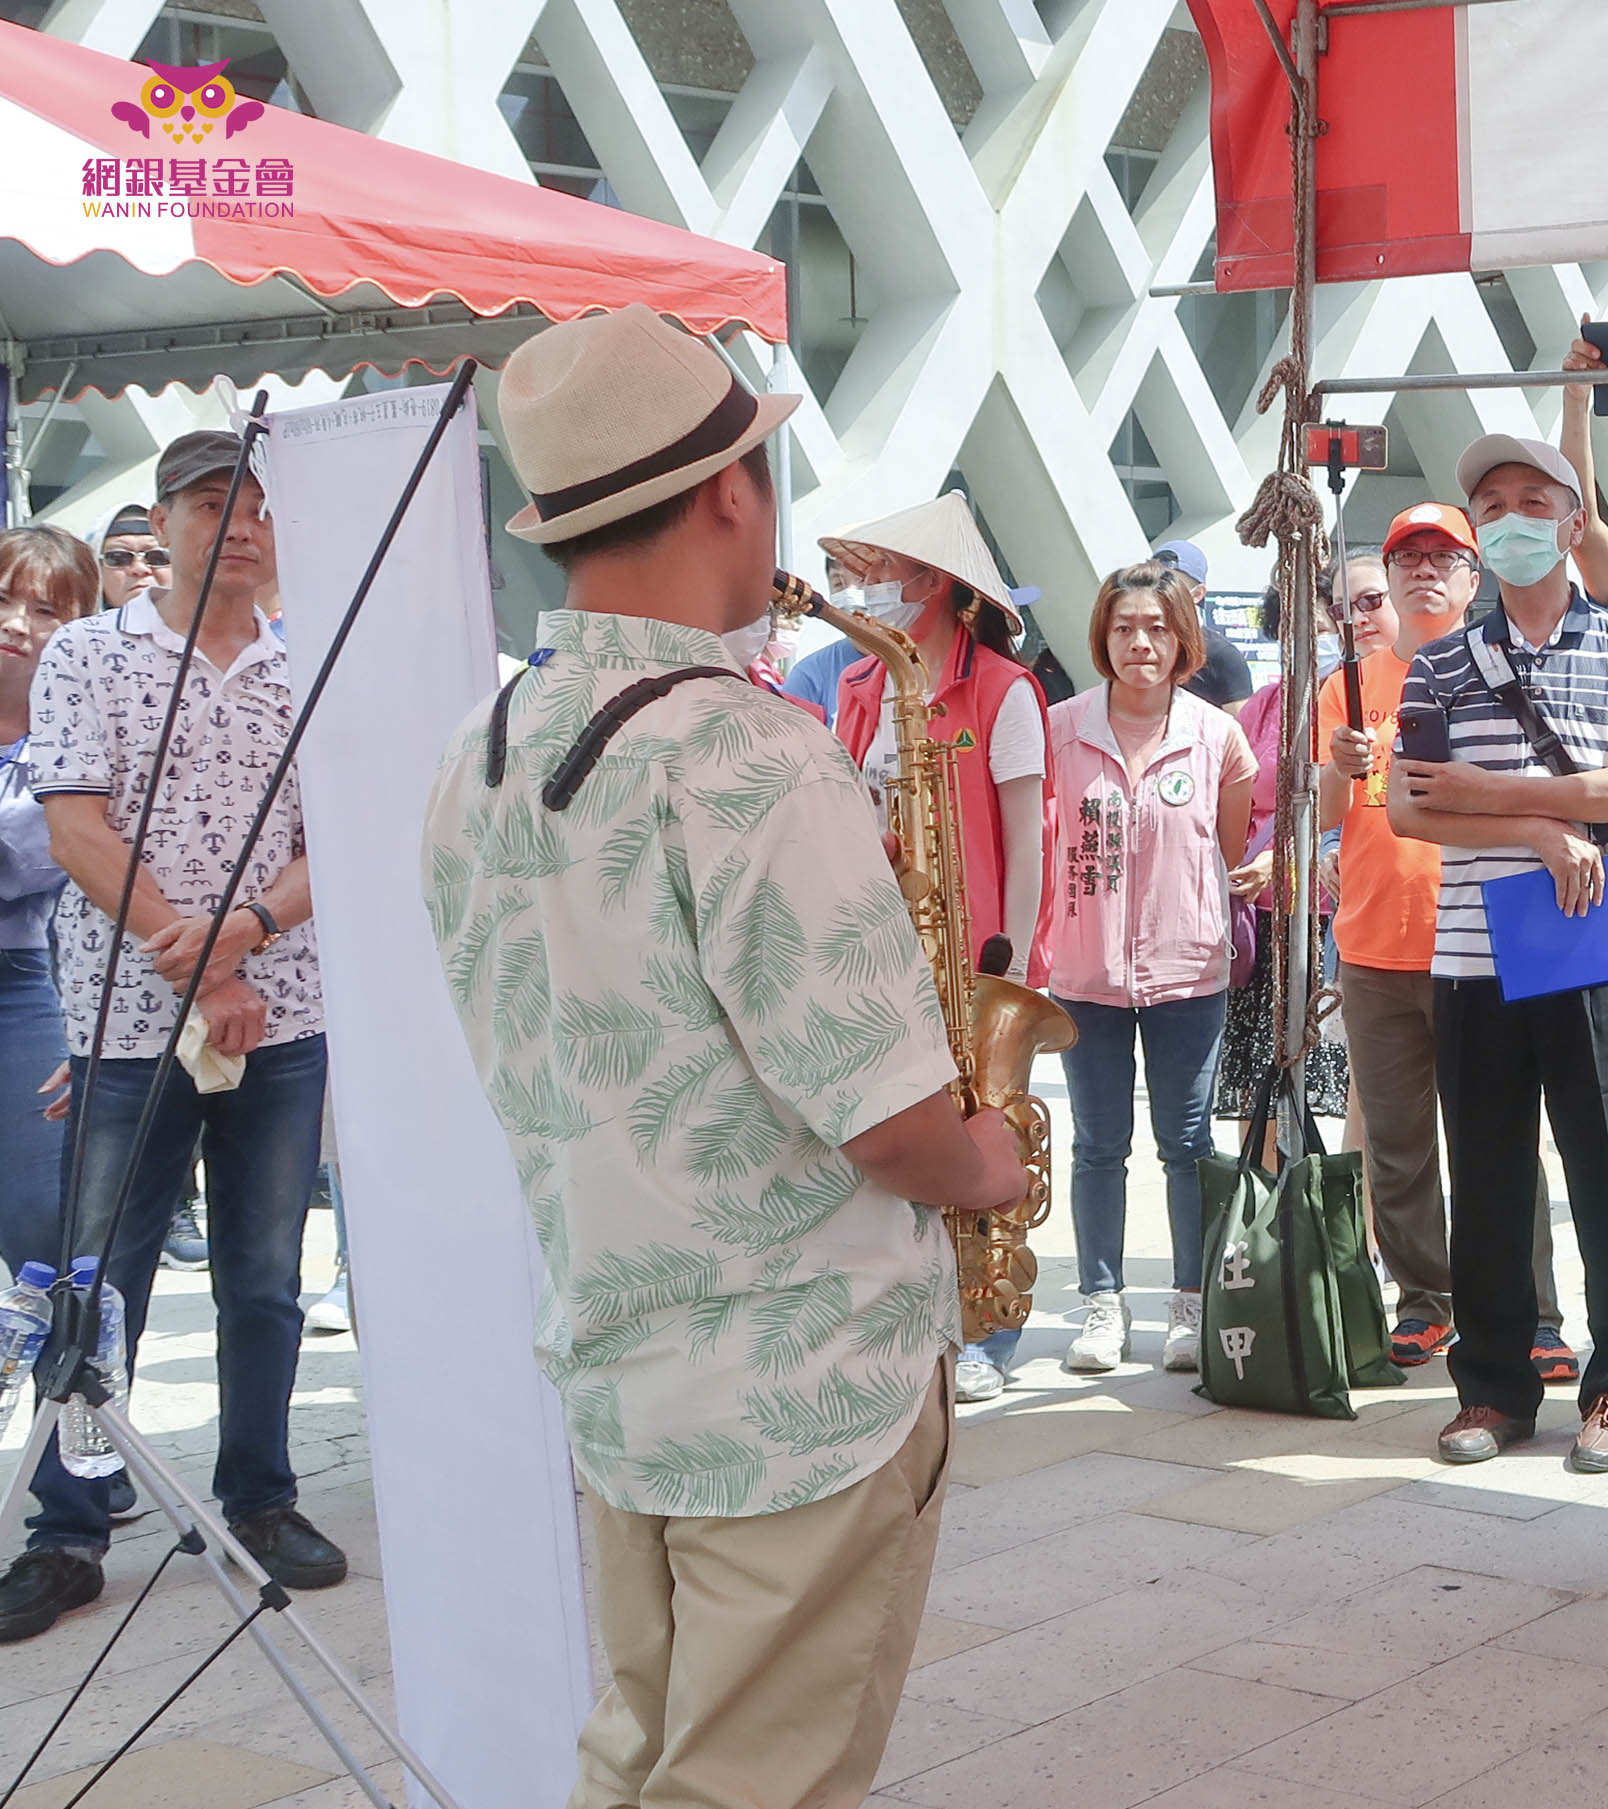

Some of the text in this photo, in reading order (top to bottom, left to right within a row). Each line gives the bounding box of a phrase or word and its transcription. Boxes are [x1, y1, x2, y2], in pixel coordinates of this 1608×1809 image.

[1364, 710, 1399, 724] 018
[1079, 797, 1102, 896] 賴燕雪
[1106, 790, 1122, 893] 南投縣議員
